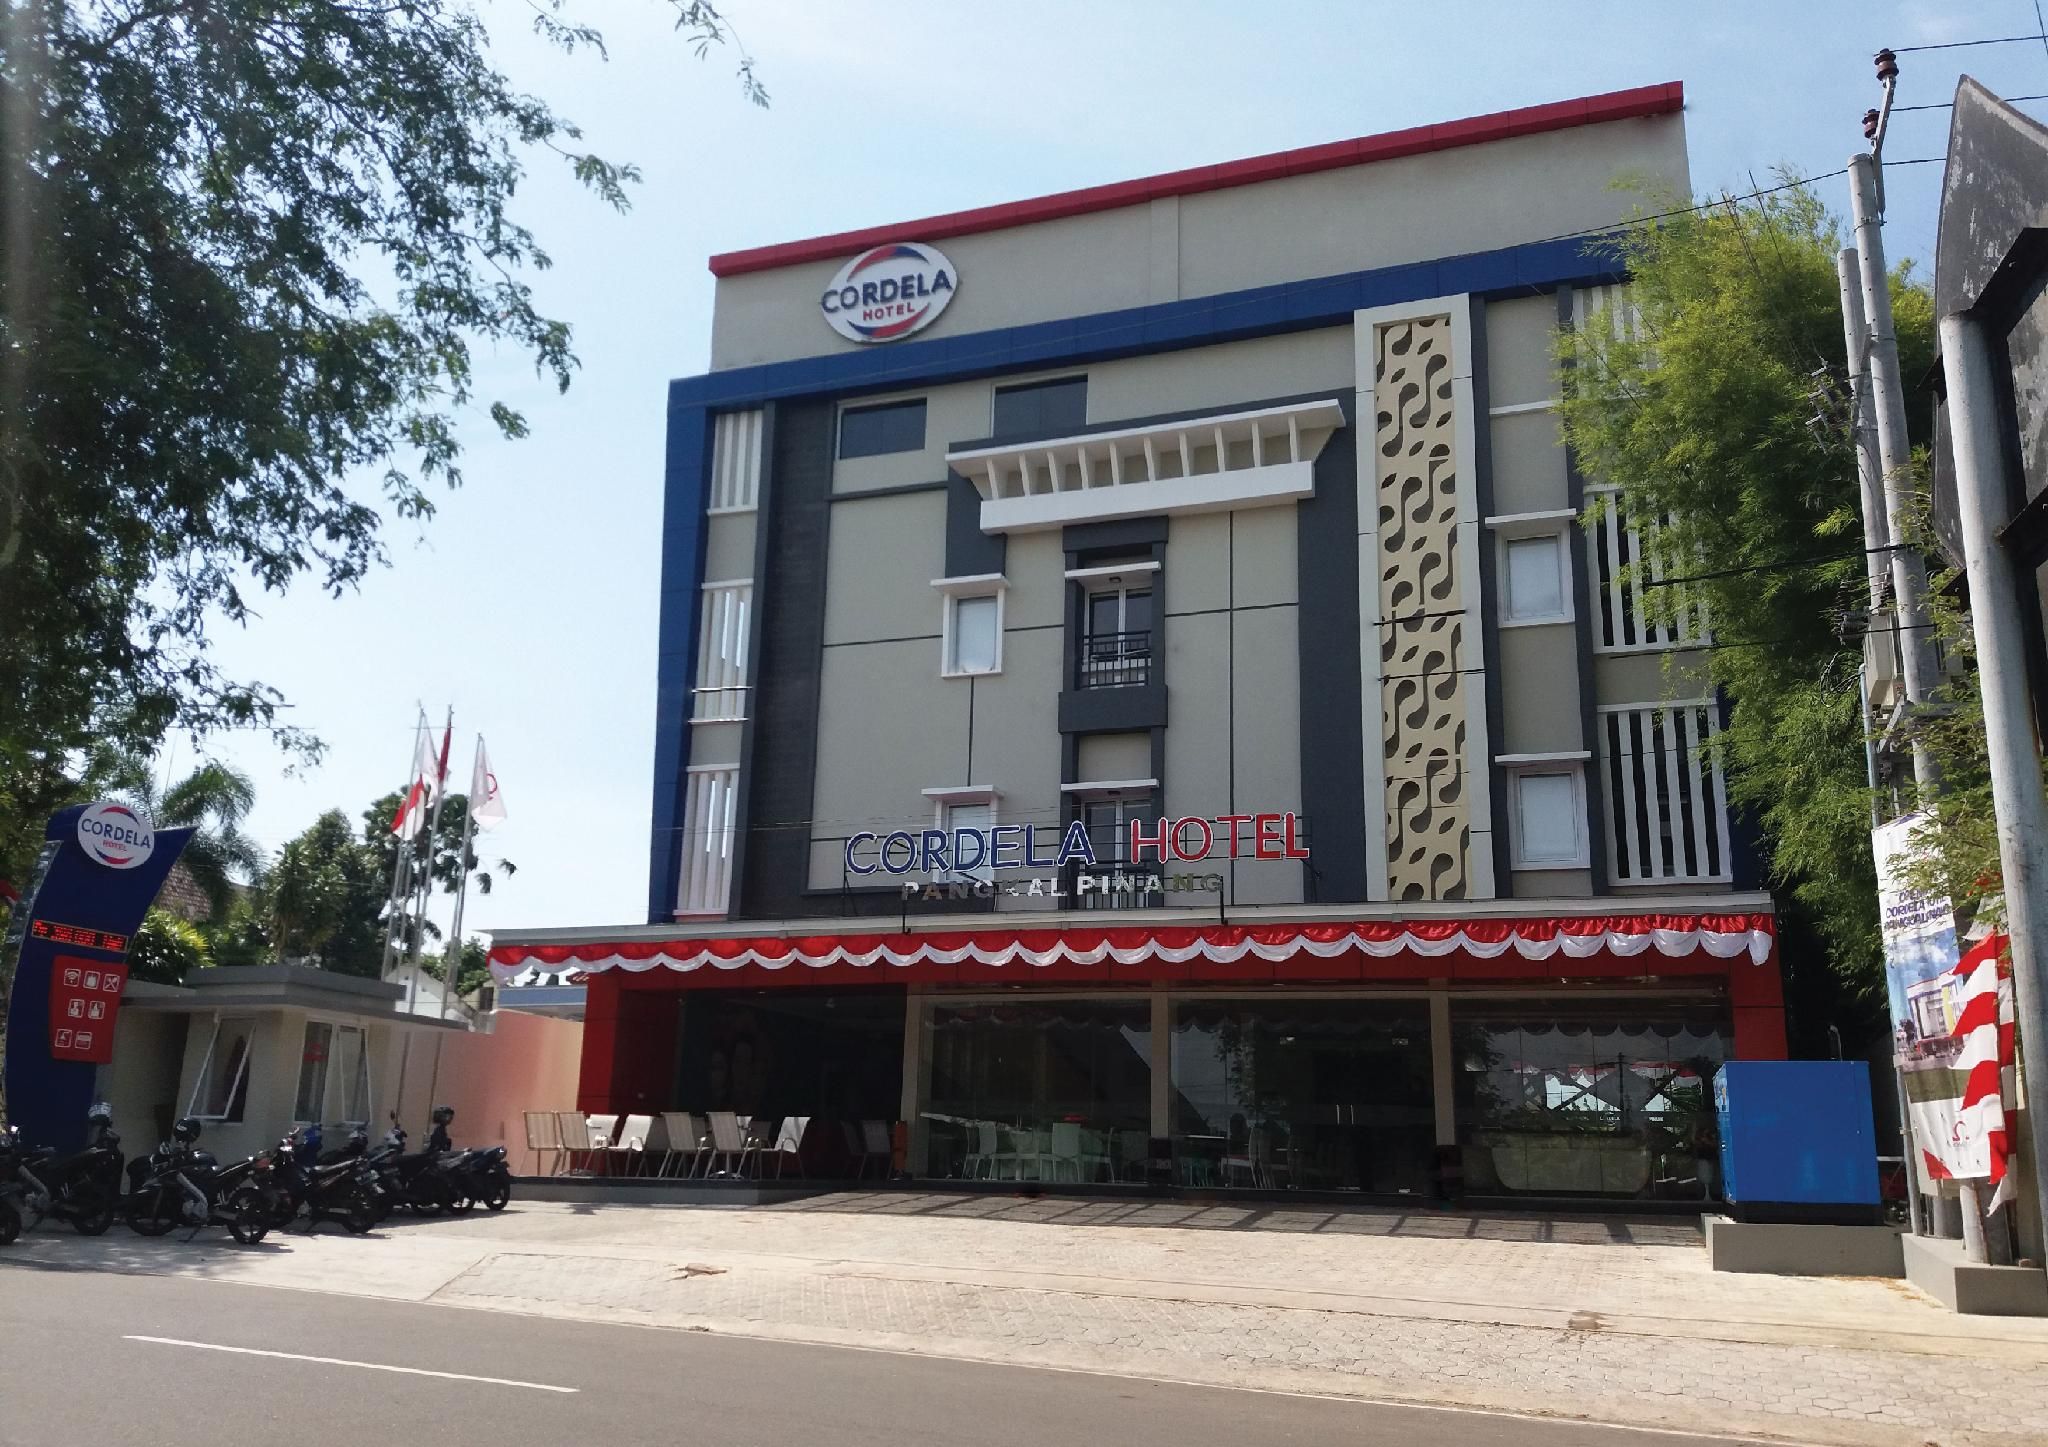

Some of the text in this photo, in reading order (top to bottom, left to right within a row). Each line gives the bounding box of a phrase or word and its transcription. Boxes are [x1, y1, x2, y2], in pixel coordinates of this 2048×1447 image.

[822, 269, 953, 313] CORDELA
[862, 303, 916, 321] HOTEL
[81, 818, 151, 848] CORDELA
[103, 839, 128, 851] HOTEL
[845, 811, 1311, 876] CORDELA HOTEL
